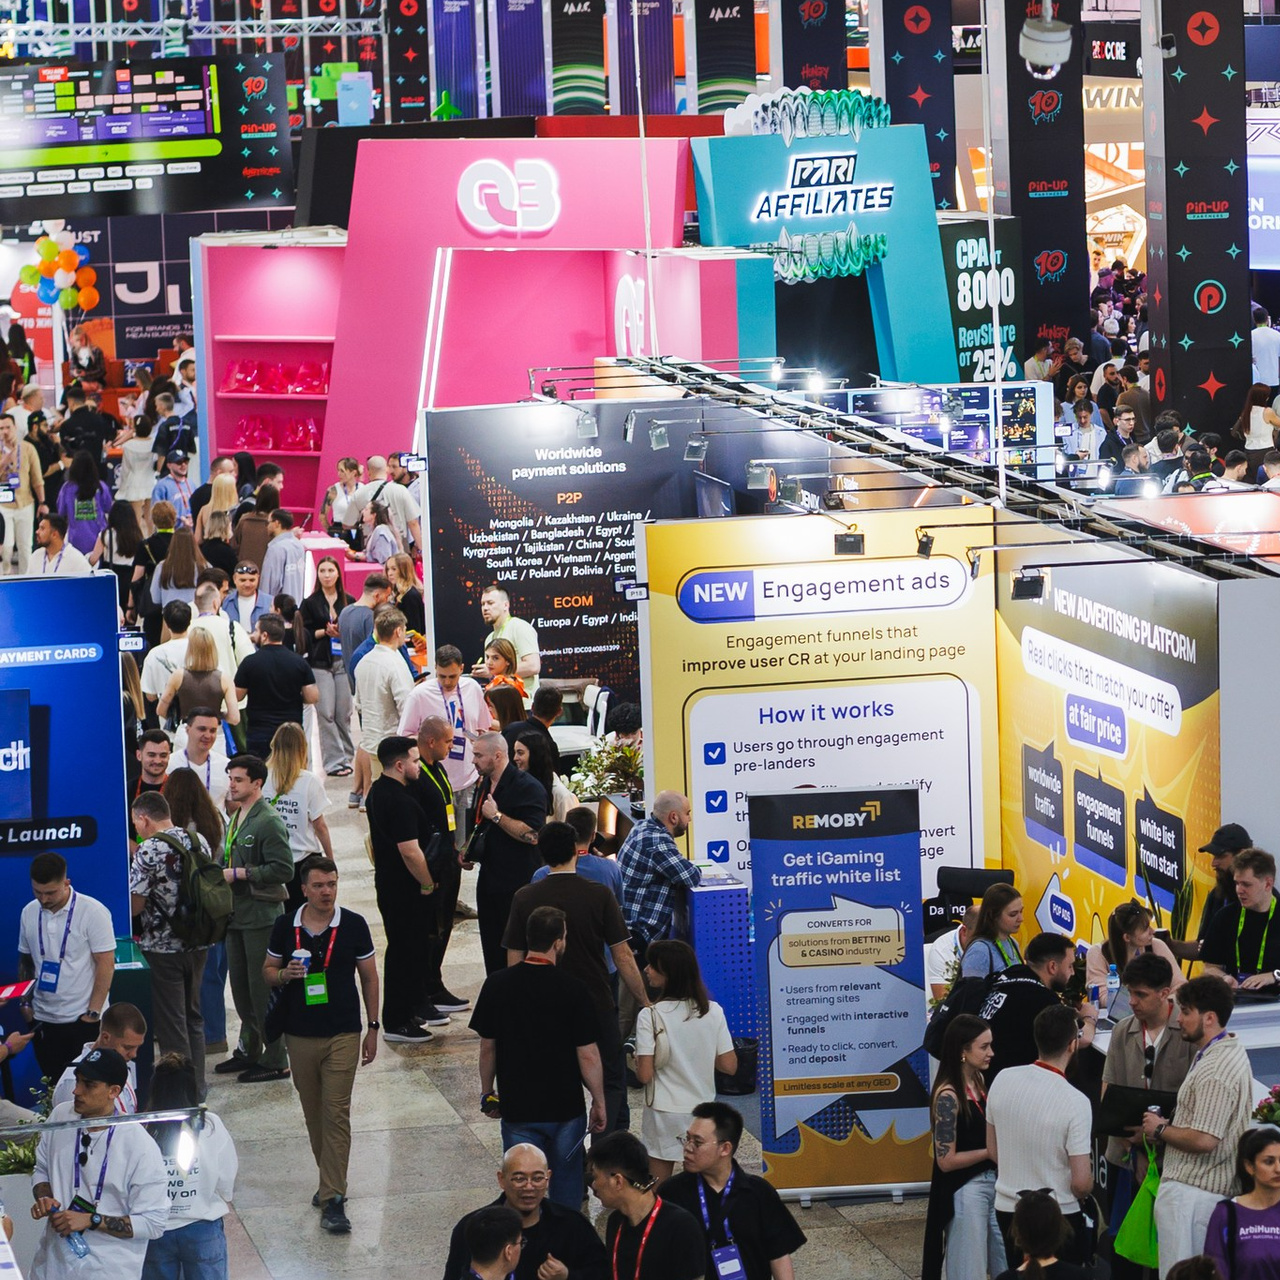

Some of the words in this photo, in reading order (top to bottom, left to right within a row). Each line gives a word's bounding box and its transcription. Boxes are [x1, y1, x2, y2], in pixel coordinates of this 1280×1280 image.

[243, 78, 266, 96] 10
[1030, 91, 1063, 113] 10
[794, 157, 855, 185] PARI
[757, 186, 894, 219] AFFILIATES
[956, 238, 988, 269] CPA
[957, 267, 1016, 311] 8000
[973, 346, 1017, 381] 25%
[535, 447, 602, 461] Worldwide
[512, 465, 567, 480] payment
[569, 460, 627, 476] solutions
[557, 492, 582, 504] P2P
[489, 517, 534, 530] Mongolia
[545, 514, 595, 526] Kazakhstan
[607, 511, 642, 522] Ukraine
[469, 531, 519, 544] Uzbekistan
[531, 527, 584, 540] Bangladesh
[595, 524, 622, 537] Egypt
[463, 545, 512, 558] Kyrgyzstan
[523, 541, 565, 554] Tajikistan
[576, 538, 603, 550] China
[486, 557, 513, 568] South
[515, 555, 542, 566] Korea
[554, 553, 592, 564] Vietnam
[497, 570, 518, 581] UAE
[529, 567, 561, 578] Poland
[573, 564, 603, 576] Bolivia
[630, 590, 643, 598] P18
[694, 582, 748, 603] NEW
[763, 573, 905, 601] Engagement
[911, 571, 950, 590] ads
[554, 595, 593, 608] ECOM
[538, 618, 571, 630] Europa
[582, 614, 608, 627] Egypt
[1054, 587, 1077, 615] NEW
[1077, 594, 1141, 645] ADVERTISING
[1142, 620, 1197, 664] PLATFORM
[726, 631, 823, 651] Engagement
[827, 627, 883, 644] funnels
[887, 625, 918, 639] that
[0, 650, 51, 664] AYMENT
[54, 647, 97, 661] CARDS
[682, 658, 746, 675] improve
[750, 655, 784, 668] user
[788, 652, 810, 666] CR
[814, 651, 829, 664] at
[834, 650, 867, 667] your
[870, 645, 925, 664] landing
[929, 644, 966, 660] page
[1028, 639, 1045, 664] Real
[1048, 644, 1073, 677] clicks
[1075, 657, 1094, 688] that
[1096, 667, 1125, 701] match
[1128, 684, 1149, 713] your
[1150, 691, 1175, 722] offer
[759, 706, 805, 725] How
[811, 703, 826, 721] it
[831, 700, 895, 720] works
[1069, 705, 1079, 723] at
[1080, 706, 1096, 731] fair
[1097, 716, 1122, 745] price
[733, 738, 774, 754] Users
[777, 740, 795, 755] go
[798, 731, 854, 750] through
[857, 727, 944, 746] engagement
[734, 755, 815, 775] pre-landers
[1028, 765, 1062, 795] worldwide
[265, 797, 298, 808] Gssip
[1035, 794, 1056, 818] traffic
[1077, 789, 1122, 826] engagement
[792, 811, 867, 830] REMOBY
[7, 823, 82, 843] Launch
[1086, 821, 1114, 850] funnels
[1140, 816, 1161, 843] white
[1162, 827, 1176, 850] list
[783, 852, 813, 867] Get
[817, 851, 885, 869] iGaming
[1140, 846, 1158, 872] from
[1159, 852, 1179, 881] start
[771, 871, 823, 888] traffic
[826, 869, 871, 885] white
[875, 867, 901, 883] list
[1052, 903, 1062, 917] POP
[1062, 907, 1071, 922] ADS
[807, 920, 852, 929] CONVERTS
[855, 919, 872, 927] FOR
[788, 937, 827, 948] solutions
[829, 937, 850, 947] from
[852, 934, 891, 945] BETTING
[809, 948, 844, 958] CASINO
[845, 946, 881, 959] industry
[785, 985, 812, 994] Users
[815, 984, 837, 993] from
[840, 981, 881, 992] relevant
[786, 996, 833, 1008] streaming
[837, 994, 860, 1004] sites
[787, 1014, 825, 1027] Engaged
[828, 1012, 851, 1023] with
[854, 1009, 909, 1021] interactive
[787, 1025, 825, 1036] funnels
[788, 1043, 817, 1056] Ready
[832, 1041, 856, 1052] click,
[858, 1039, 898, 1050] convert,
[808, 1053, 847, 1066] deposit
[783, 1082, 820, 1092] Limitless
[823, 1081, 845, 1091] scale
[873, 1078, 891, 1087] GEO
